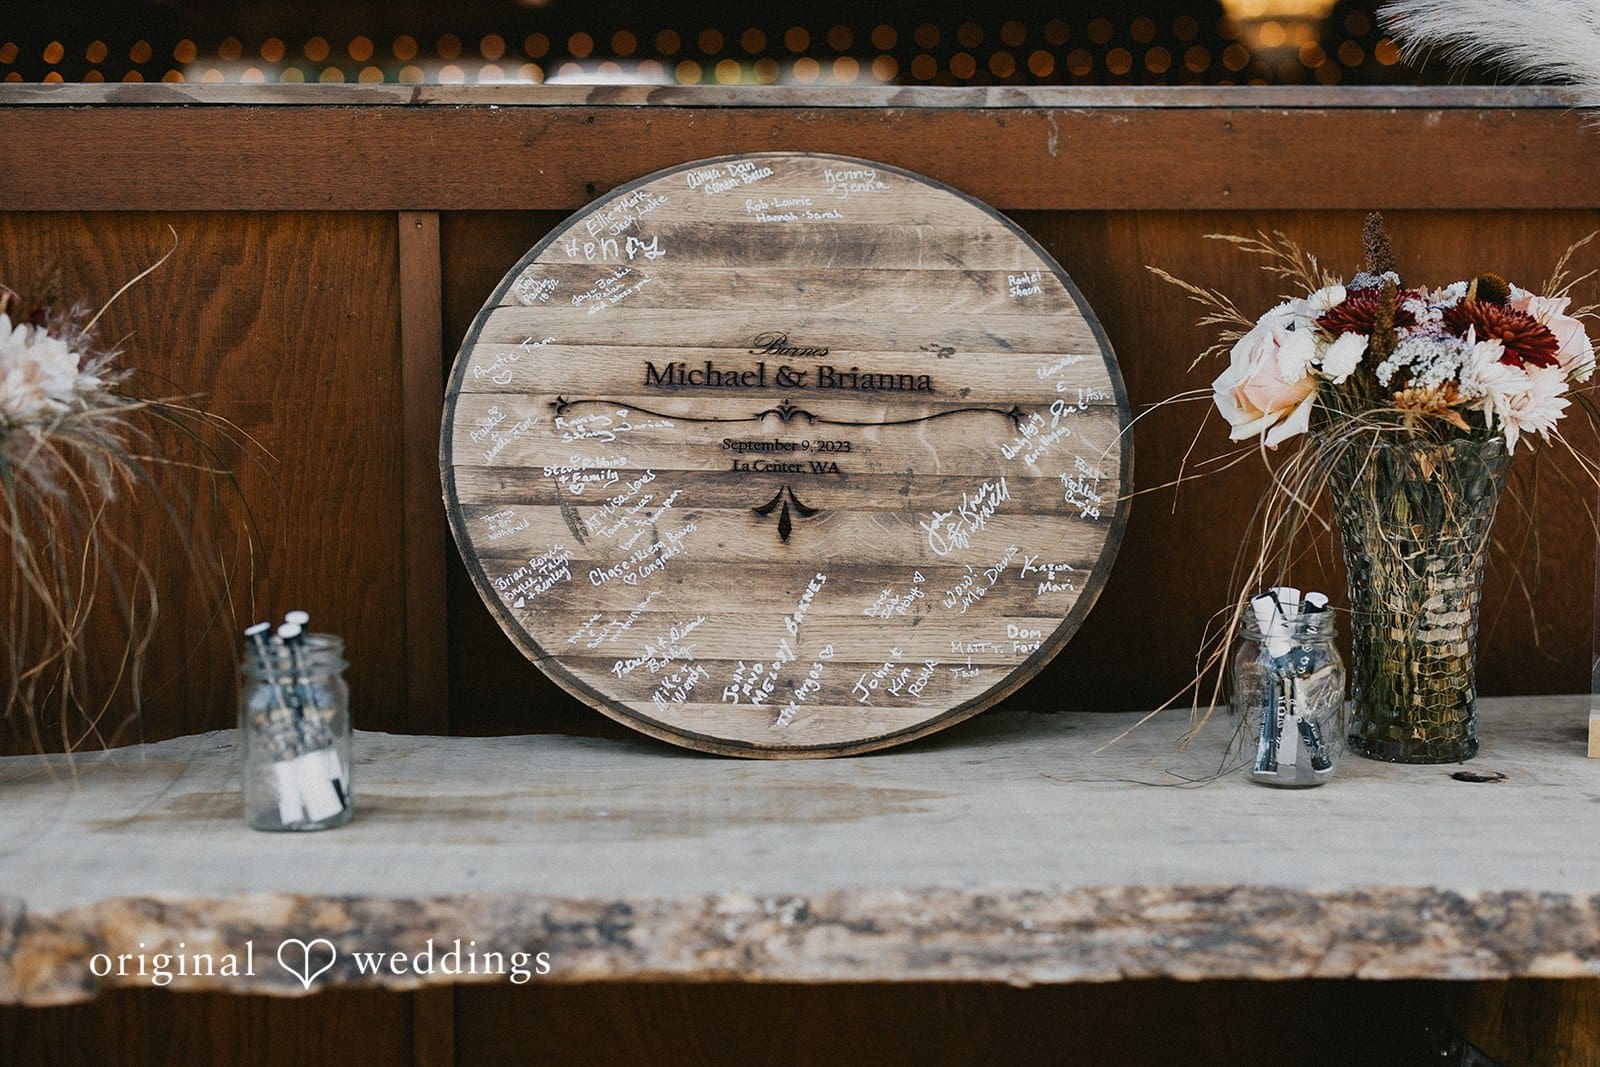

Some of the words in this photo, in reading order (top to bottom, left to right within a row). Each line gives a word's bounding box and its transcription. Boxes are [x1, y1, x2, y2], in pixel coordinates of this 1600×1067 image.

[749, 331, 830, 357] Barnes
[644, 361, 767, 387] Michael
[775, 365, 807, 388] &
[816, 365, 933, 392] Brianna
[722, 438, 799, 453] September
[801, 440, 814, 453] 9,
[817, 440, 851, 453] 2023
[733, 460, 750, 472] La
[809, 460, 840, 473] WA
[571, 469, 620, 488] Family
[627, 469, 657, 496] Jones
[588, 560, 630, 587] Chase
[1006, 623, 1042, 640] Dom
